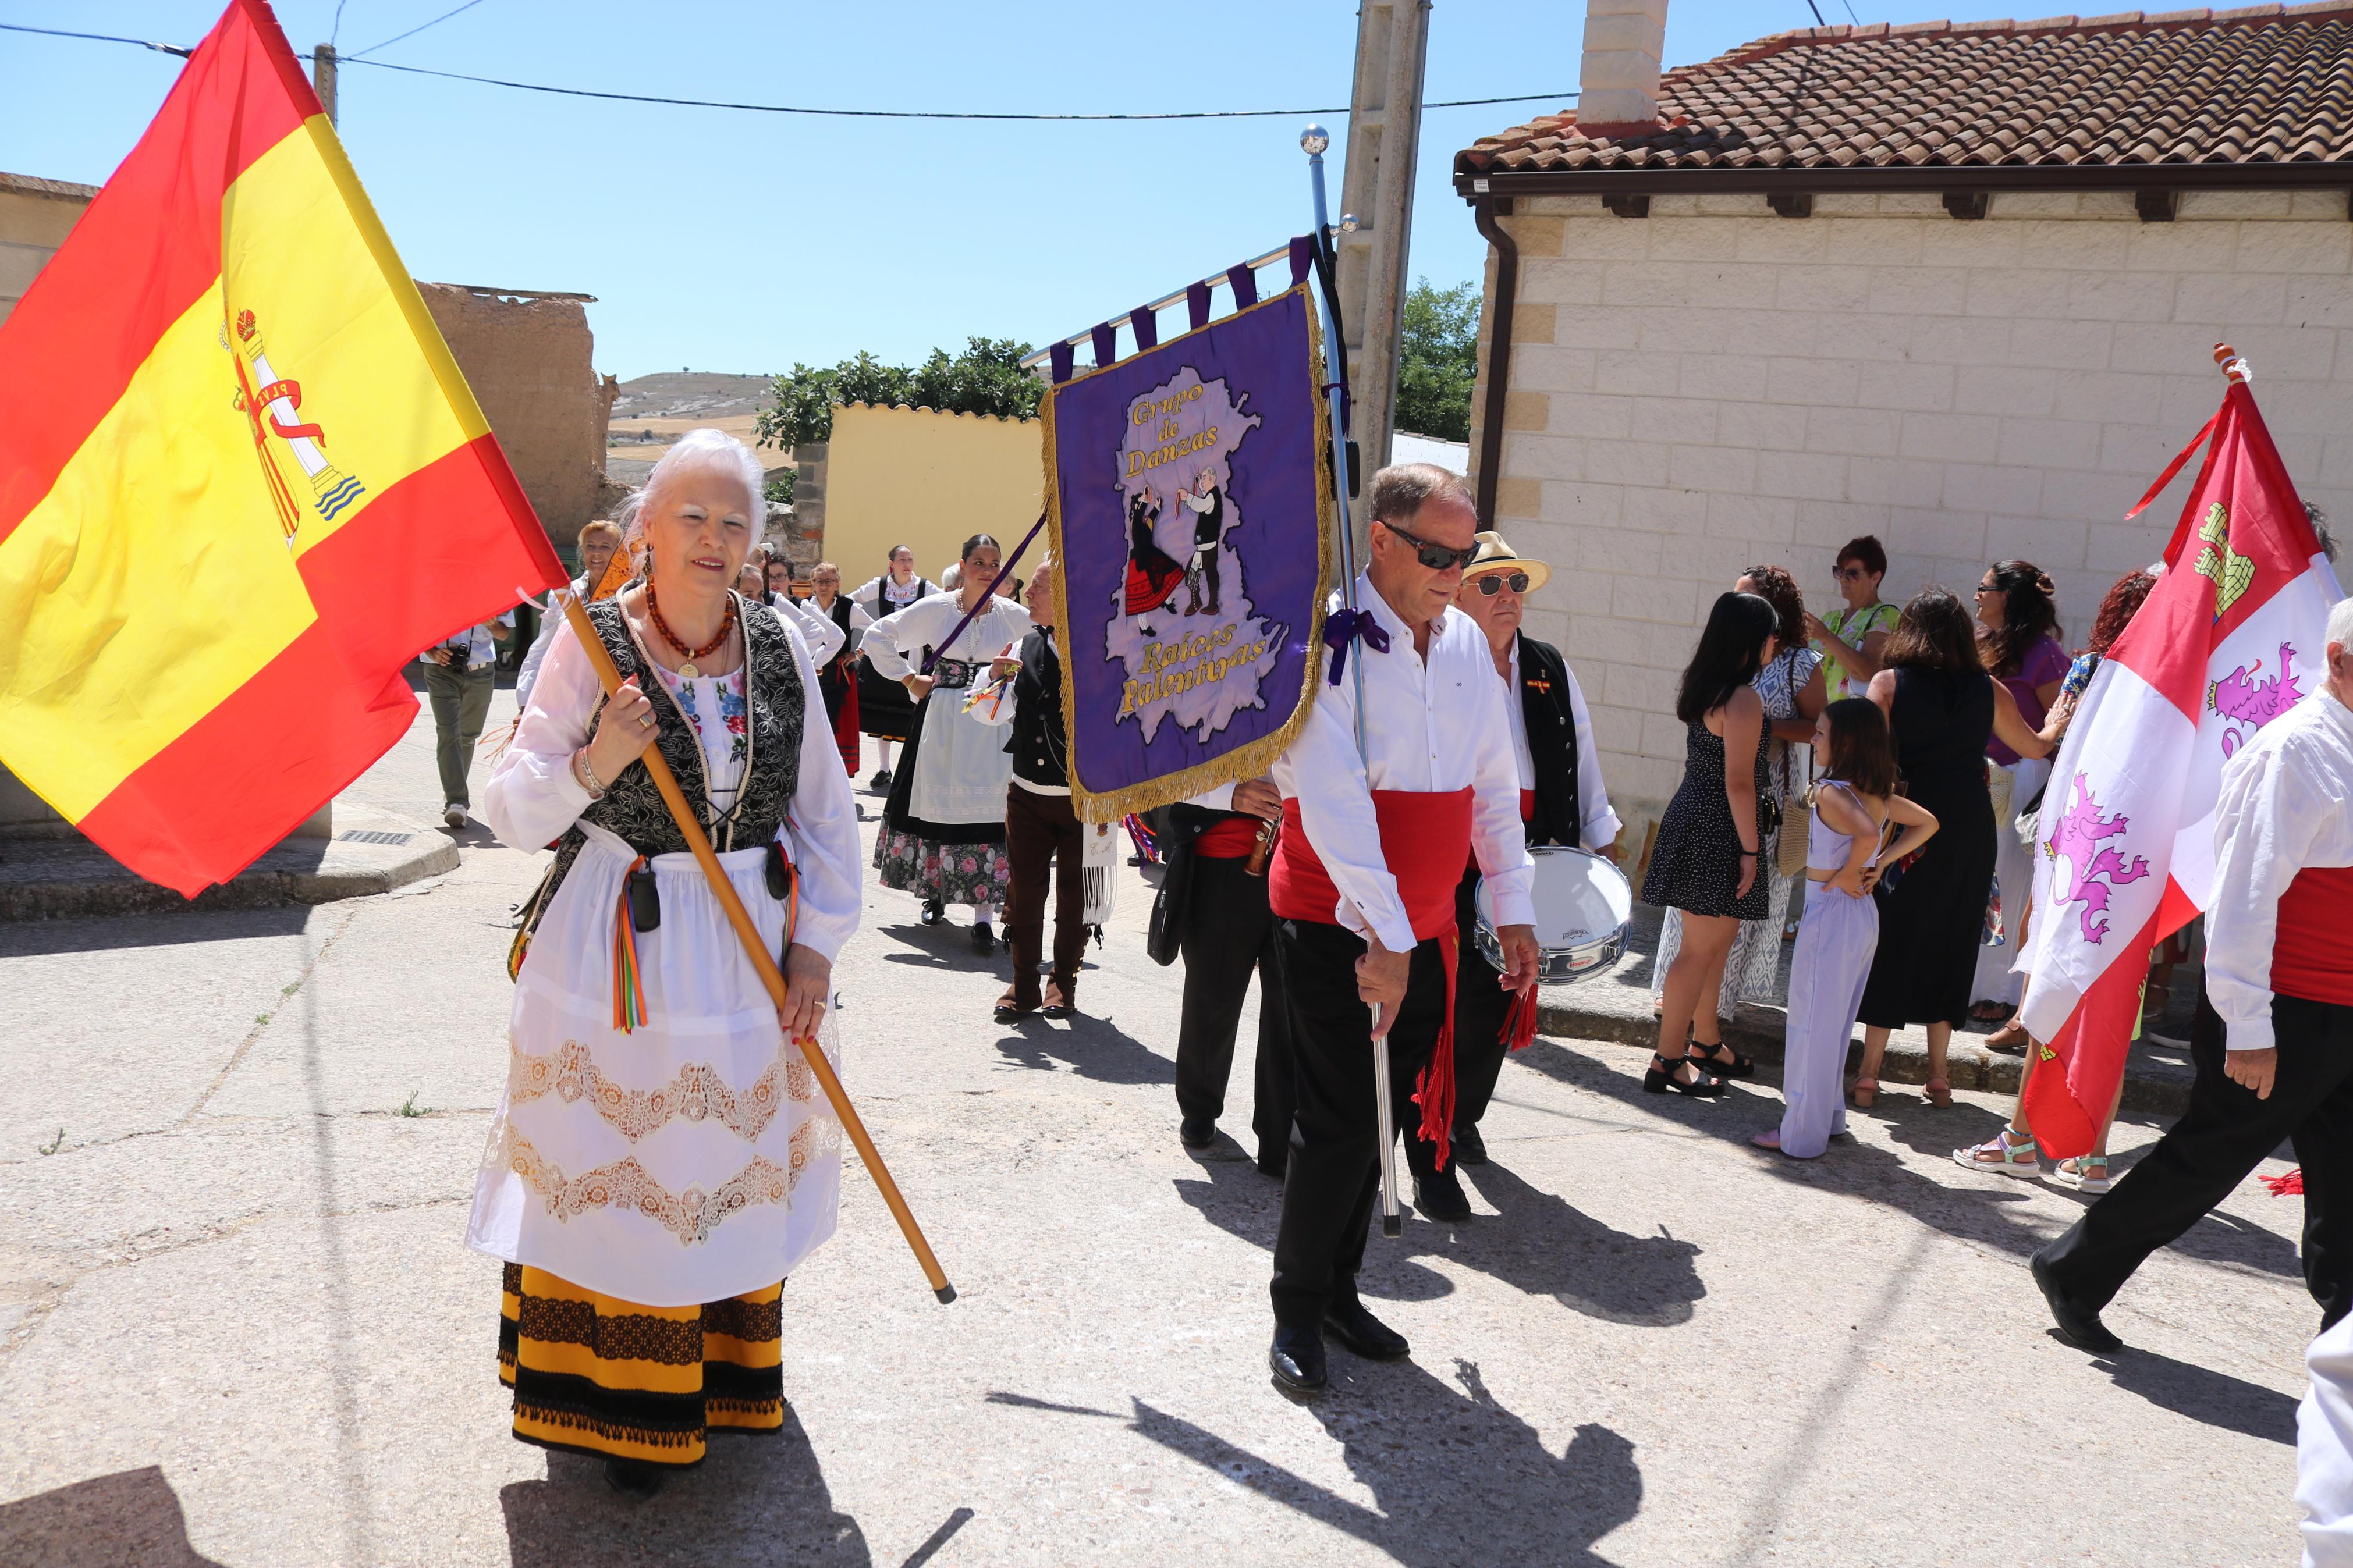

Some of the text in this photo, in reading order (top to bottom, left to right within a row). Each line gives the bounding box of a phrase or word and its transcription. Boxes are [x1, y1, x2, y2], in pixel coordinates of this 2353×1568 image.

[1133, 384, 1204, 426] Grupo
[1126, 426, 1218, 479] Danzas
[1158, 419, 1179, 442] de
[1138, 624, 1237, 674] Raíces
